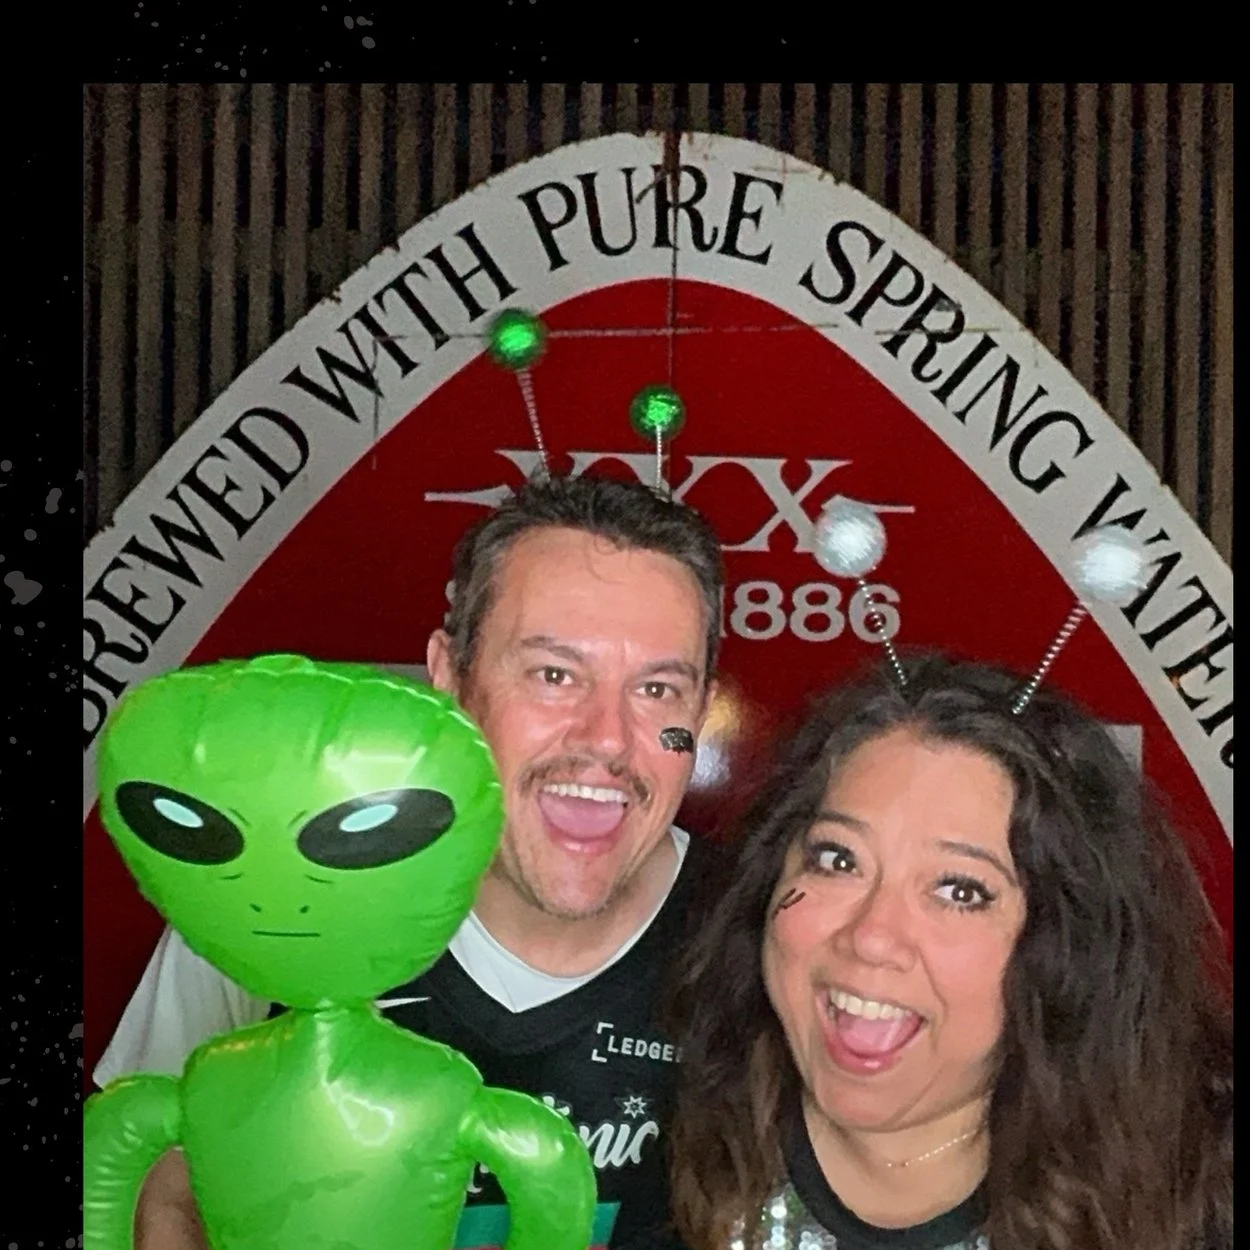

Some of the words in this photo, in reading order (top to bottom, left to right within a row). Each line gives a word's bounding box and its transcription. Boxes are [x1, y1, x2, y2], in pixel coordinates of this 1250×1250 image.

[282, 223, 518, 425] WITH
[517, 164, 783, 271] PURE
[798, 221, 1094, 493] SPRING
[1071, 473, 1233, 769] WATE
[720, 581, 902, 643] 886
